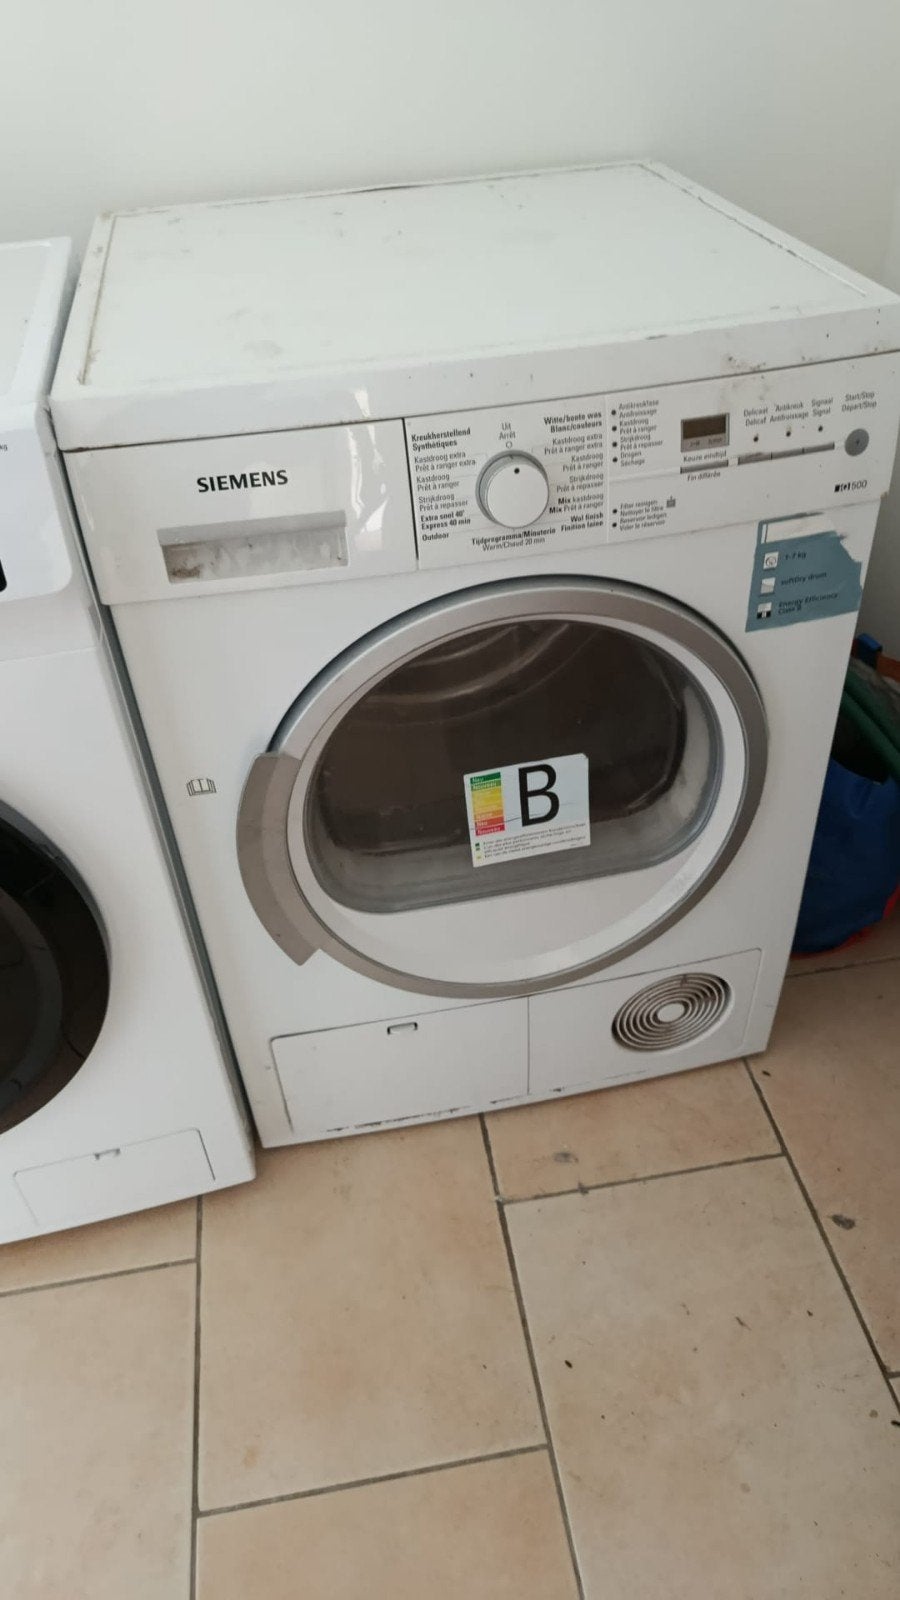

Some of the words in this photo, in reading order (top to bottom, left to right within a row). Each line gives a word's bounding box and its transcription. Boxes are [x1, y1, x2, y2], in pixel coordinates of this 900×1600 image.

[550, 421, 602, 433] Blanc/couleurs
[411, 428, 471, 442] Kreukherstellend
[587, 433, 602, 441] extra
[197, 469, 289, 493] SIEMENS
[420, 514, 438, 522] Extra
[585, 512, 604, 521] finish
[421, 521, 448, 531] Express
[449, 518, 457, 526] 40
[458, 517, 471, 525] min
[561, 523, 586, 532] Finition
[422, 532, 449, 541] Outdoor
[518, 764, 560, 827] B
